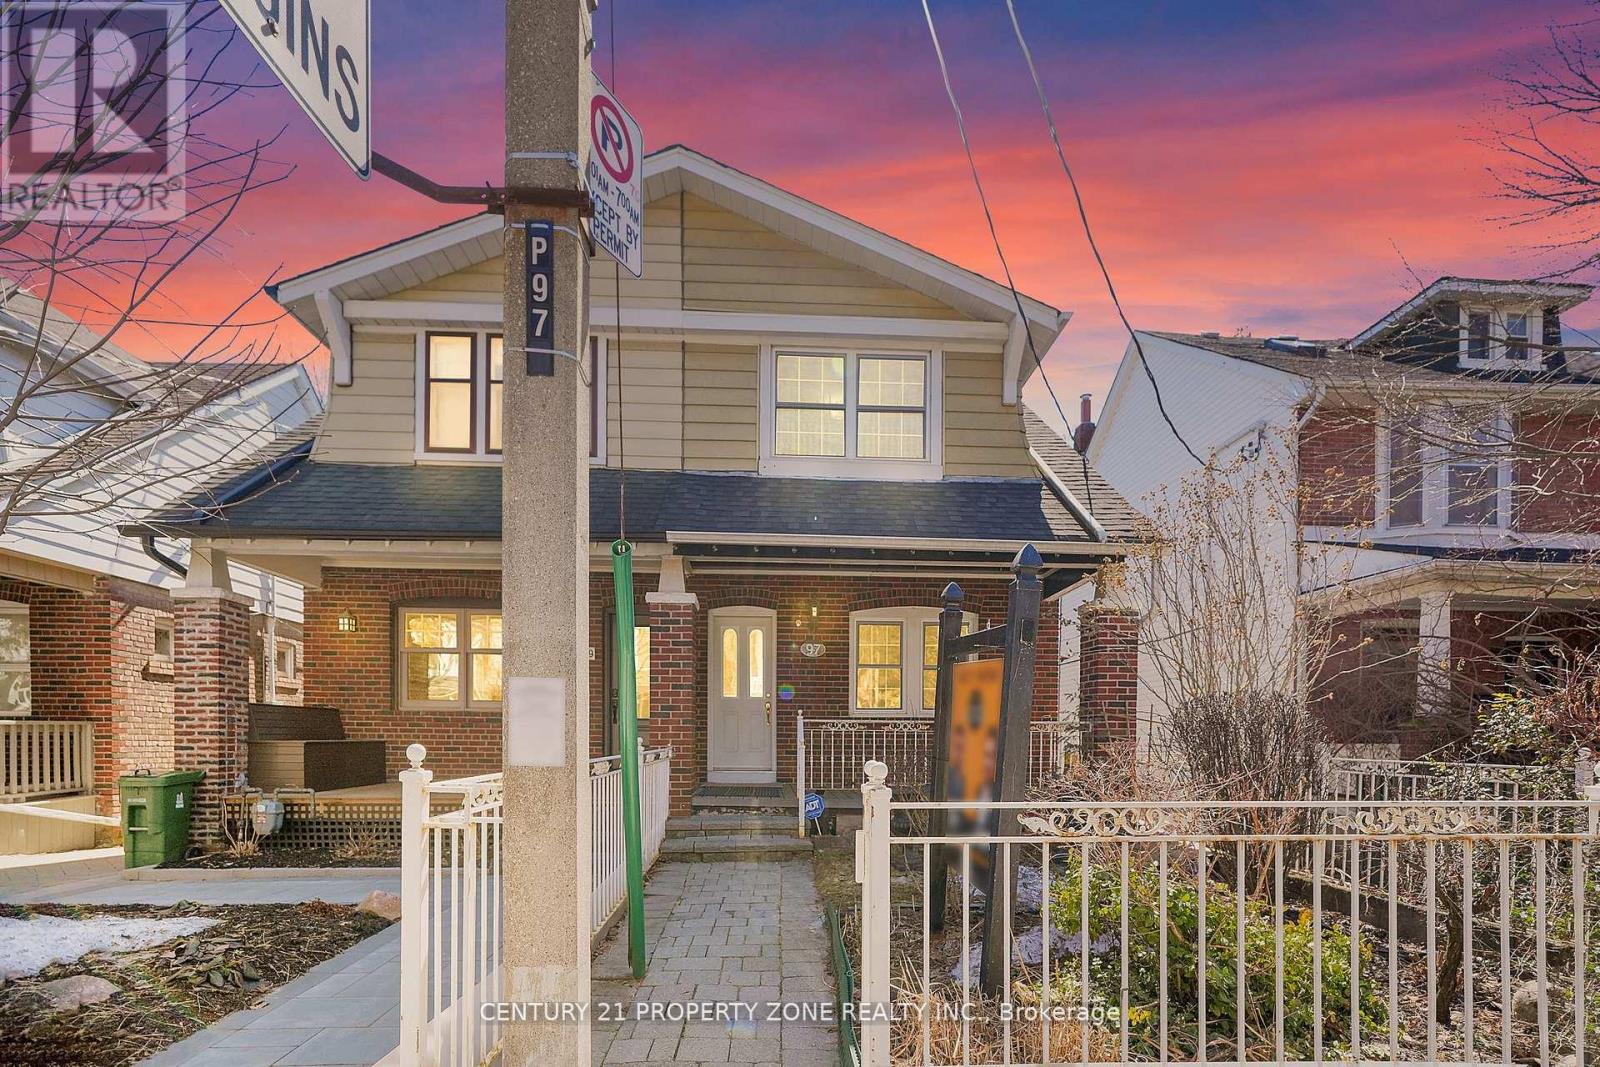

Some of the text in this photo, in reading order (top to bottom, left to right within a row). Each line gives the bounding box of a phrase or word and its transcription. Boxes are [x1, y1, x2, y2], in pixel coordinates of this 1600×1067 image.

[254, 0, 360, 132] INS
[593, 217, 629, 263] PERMIT
[626, 223, 639, 250] BY
[805, 643, 820, 654] 97
